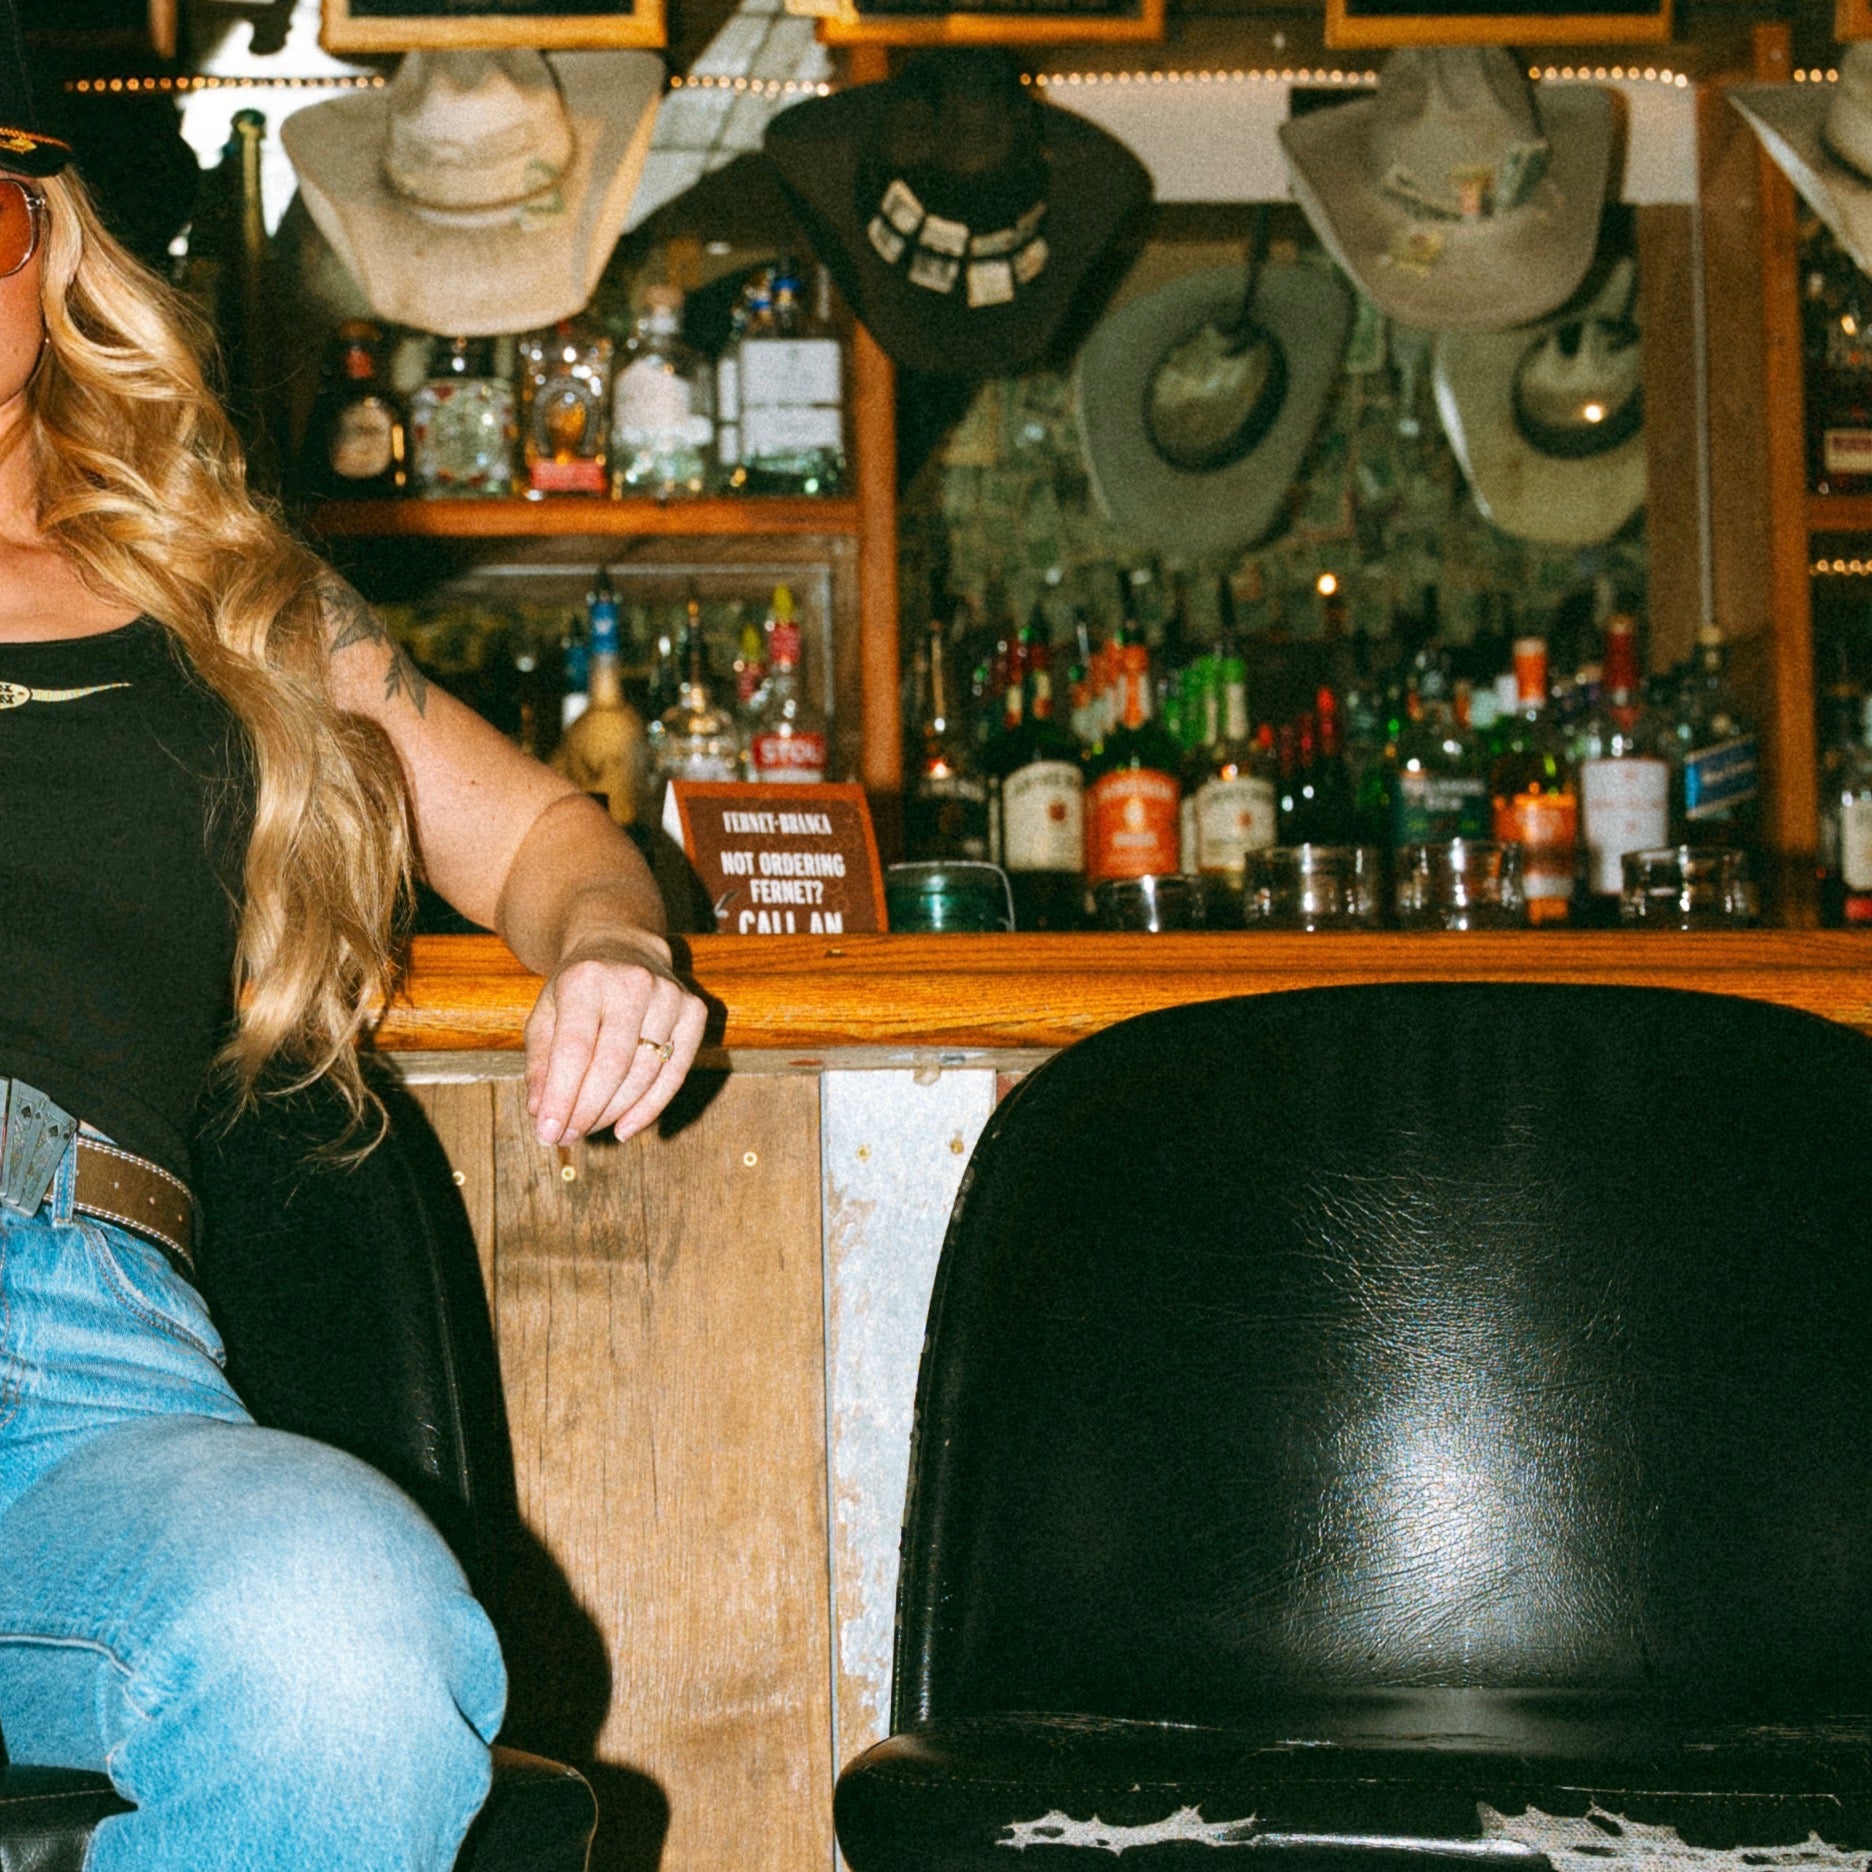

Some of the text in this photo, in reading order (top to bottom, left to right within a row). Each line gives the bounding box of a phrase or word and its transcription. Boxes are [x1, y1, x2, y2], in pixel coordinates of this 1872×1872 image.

[722, 809, 833, 835] FERNET-BRANCA
[720, 850, 847, 880] NOT ORDERING
[749, 878, 825, 906] FERNET?
